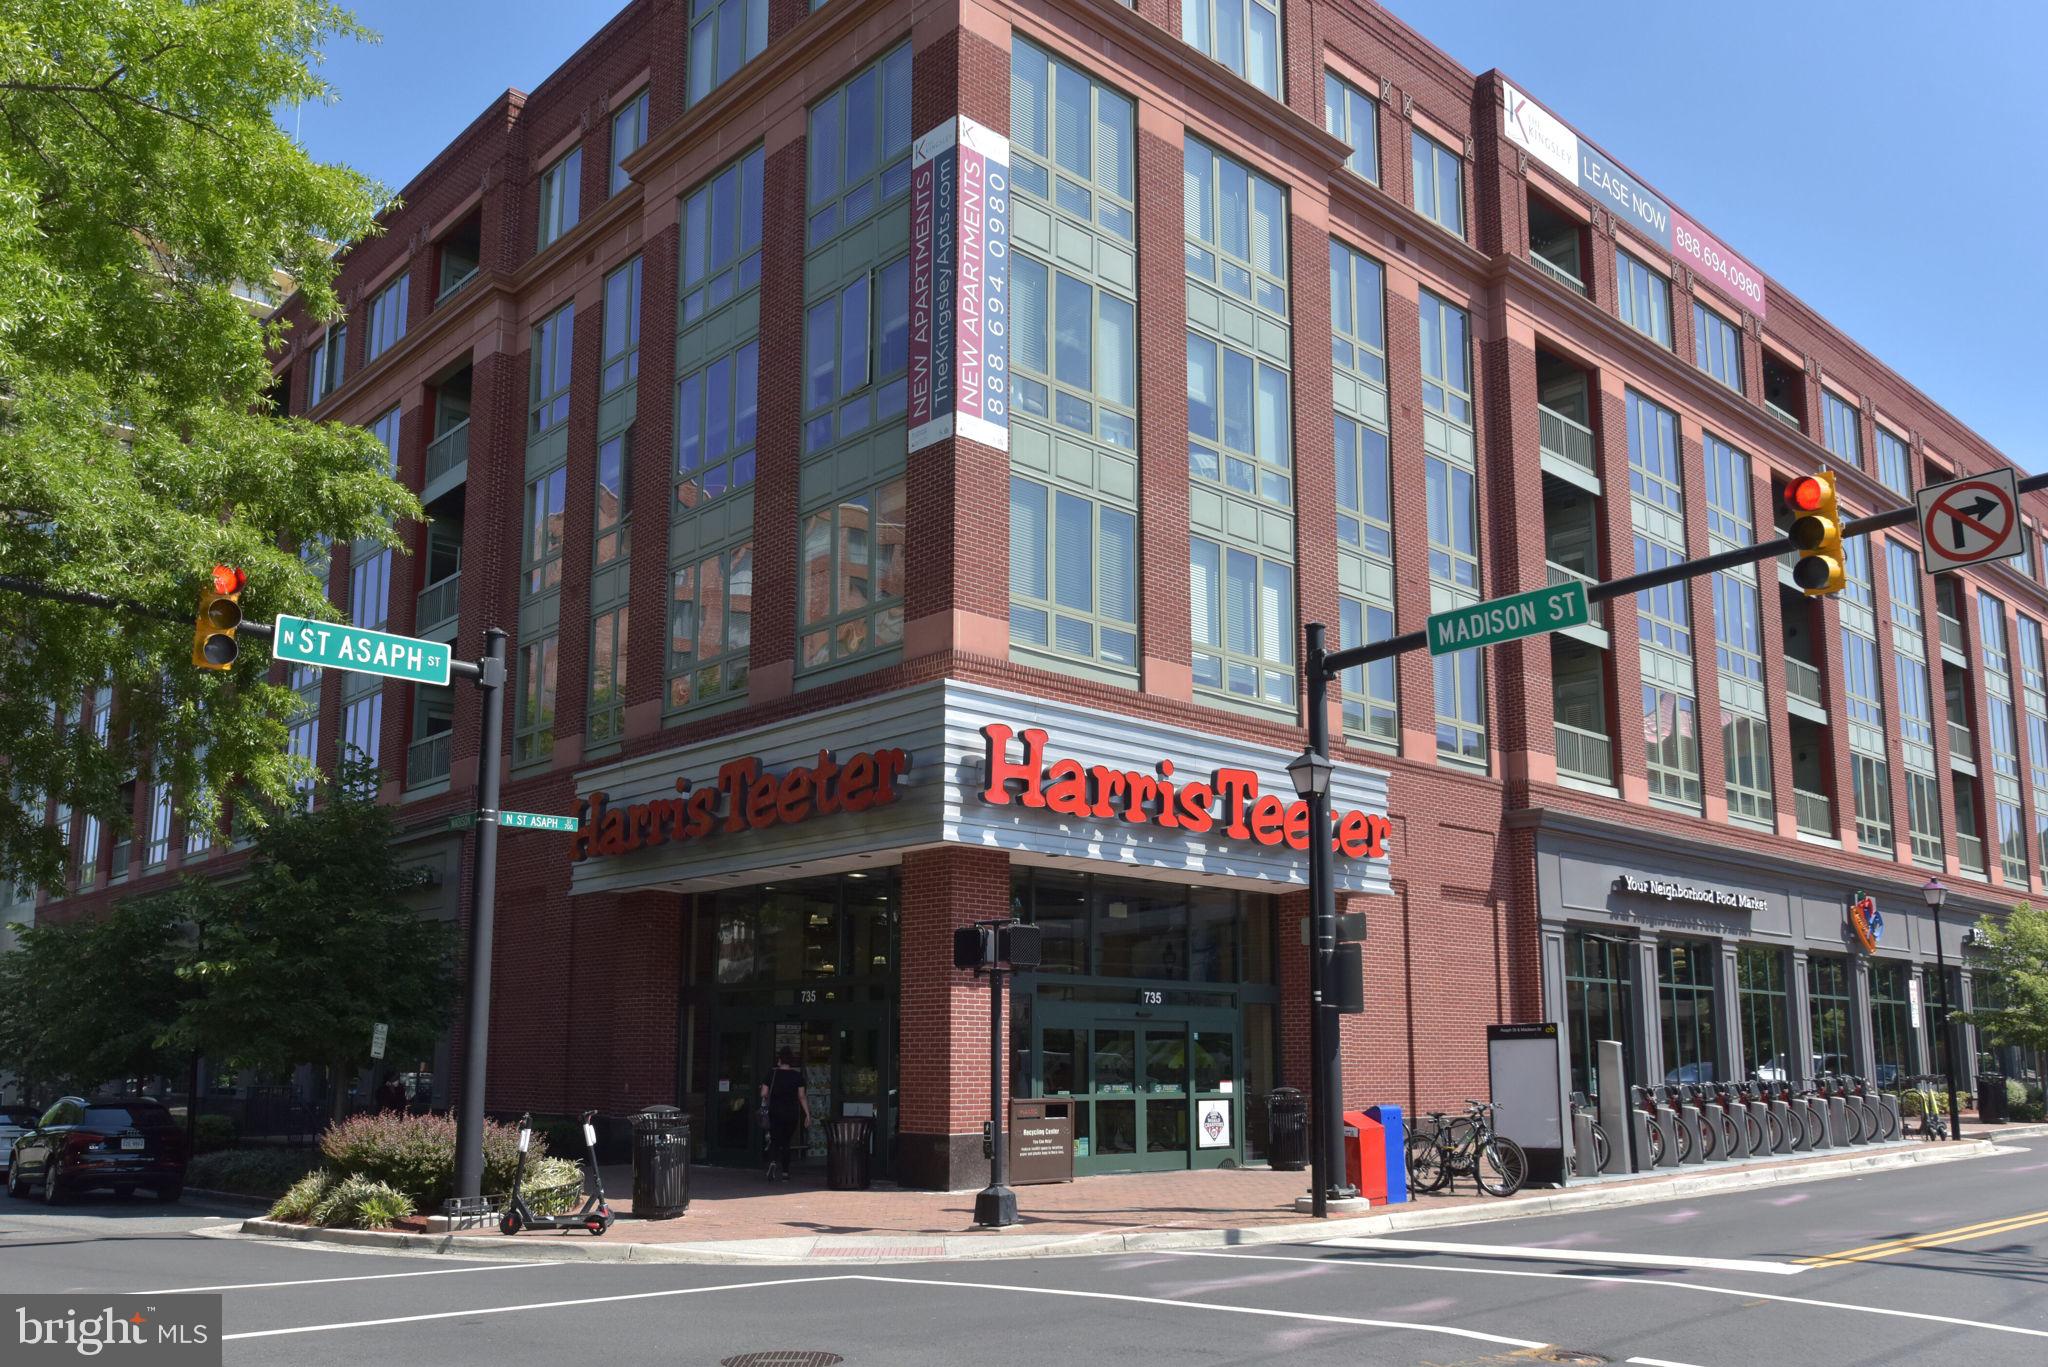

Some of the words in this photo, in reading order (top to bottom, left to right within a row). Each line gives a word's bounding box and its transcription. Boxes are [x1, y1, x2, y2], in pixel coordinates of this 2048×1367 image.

[1528, 126, 1572, 164] KINGSLEY
[1583, 156, 1629, 207] LEASE
[1632, 193, 1666, 232] NOW
[914, 171, 930, 342] APARTMENTS
[962, 160, 981, 337] APARTMENTS
[1676, 227, 1761, 301] 888.694.0980
[935, 159, 951, 408] TheKingsleyApts.com
[988, 173, 1005, 415] 888.694.0980
[913, 355, 928, 418] NEW
[962, 345, 978, 407] NEW
[284, 630, 294, 645] N
[299, 628, 331, 656] ST
[338, 635, 422, 672] ASAPH
[427, 656, 441, 668] ST
[1438, 601, 1537, 646] MADISON
[1548, 592, 1575, 621] ST
[506, 814, 513, 825] N
[516, 815, 527, 826] ST
[530, 816, 558, 828] ASAPH
[569, 776, 717, 862] Harris
[718, 748, 908, 834] Teeter
[981, 723, 1213, 834] Harris
[1212, 768, 1391, 859] Teeer
[1624, 875, 1649, 892] Your
[1650, 880, 1714, 904] Neighborhood
[1716, 890, 1737, 907] Food
[1738, 894, 1768, 911] Market
[801, 990, 816, 1002] 735
[1144, 991, 1162, 1004] 735
[1023, 1128, 1045, 1136] Recycling
